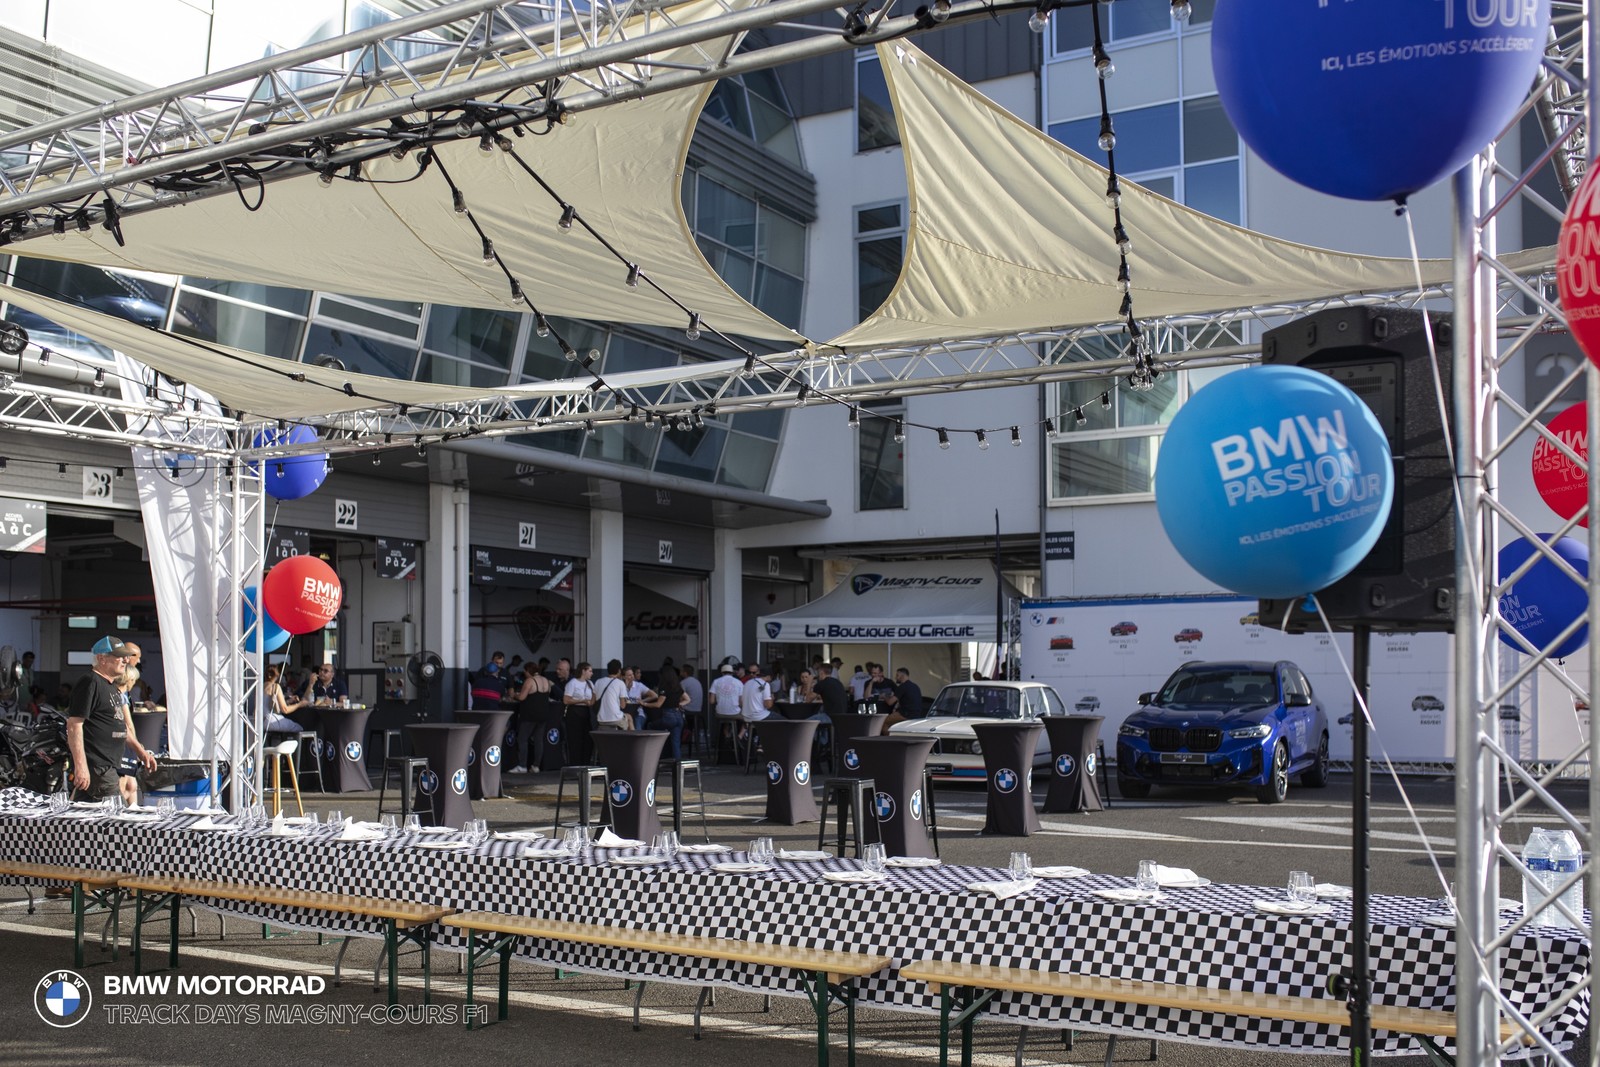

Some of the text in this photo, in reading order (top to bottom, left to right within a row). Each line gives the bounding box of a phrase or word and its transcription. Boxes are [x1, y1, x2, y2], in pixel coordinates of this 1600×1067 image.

[1321, 57, 1344, 71] ICI,
[1347, 51, 1375, 67] LES
[1378, 40, 1456, 63] ÉMOTIONS
[1211, 409, 1348, 481] BMW
[85, 472, 111, 498] 23
[1223, 451, 1361, 507] PASSION
[1303, 473, 1381, 512] TOUR
[337, 503, 356, 525] 22
[10, 523, 19, 535] à
[23, 524, 32, 536] C
[521, 526, 534, 545] 21
[282, 546, 288, 557] à
[660, 543, 672, 560] 20
[385, 556, 407, 568] P à Z
[496, 565, 525, 576] SIMULATEURS
[531, 569, 551, 577] CONDUITE
[770, 558, 779, 573] 19
[304, 577, 340, 600] BMW
[879, 575, 983, 587] Magny-Cours
[301, 590, 339, 608] PASSION
[1504, 604, 1542, 624] OUR
